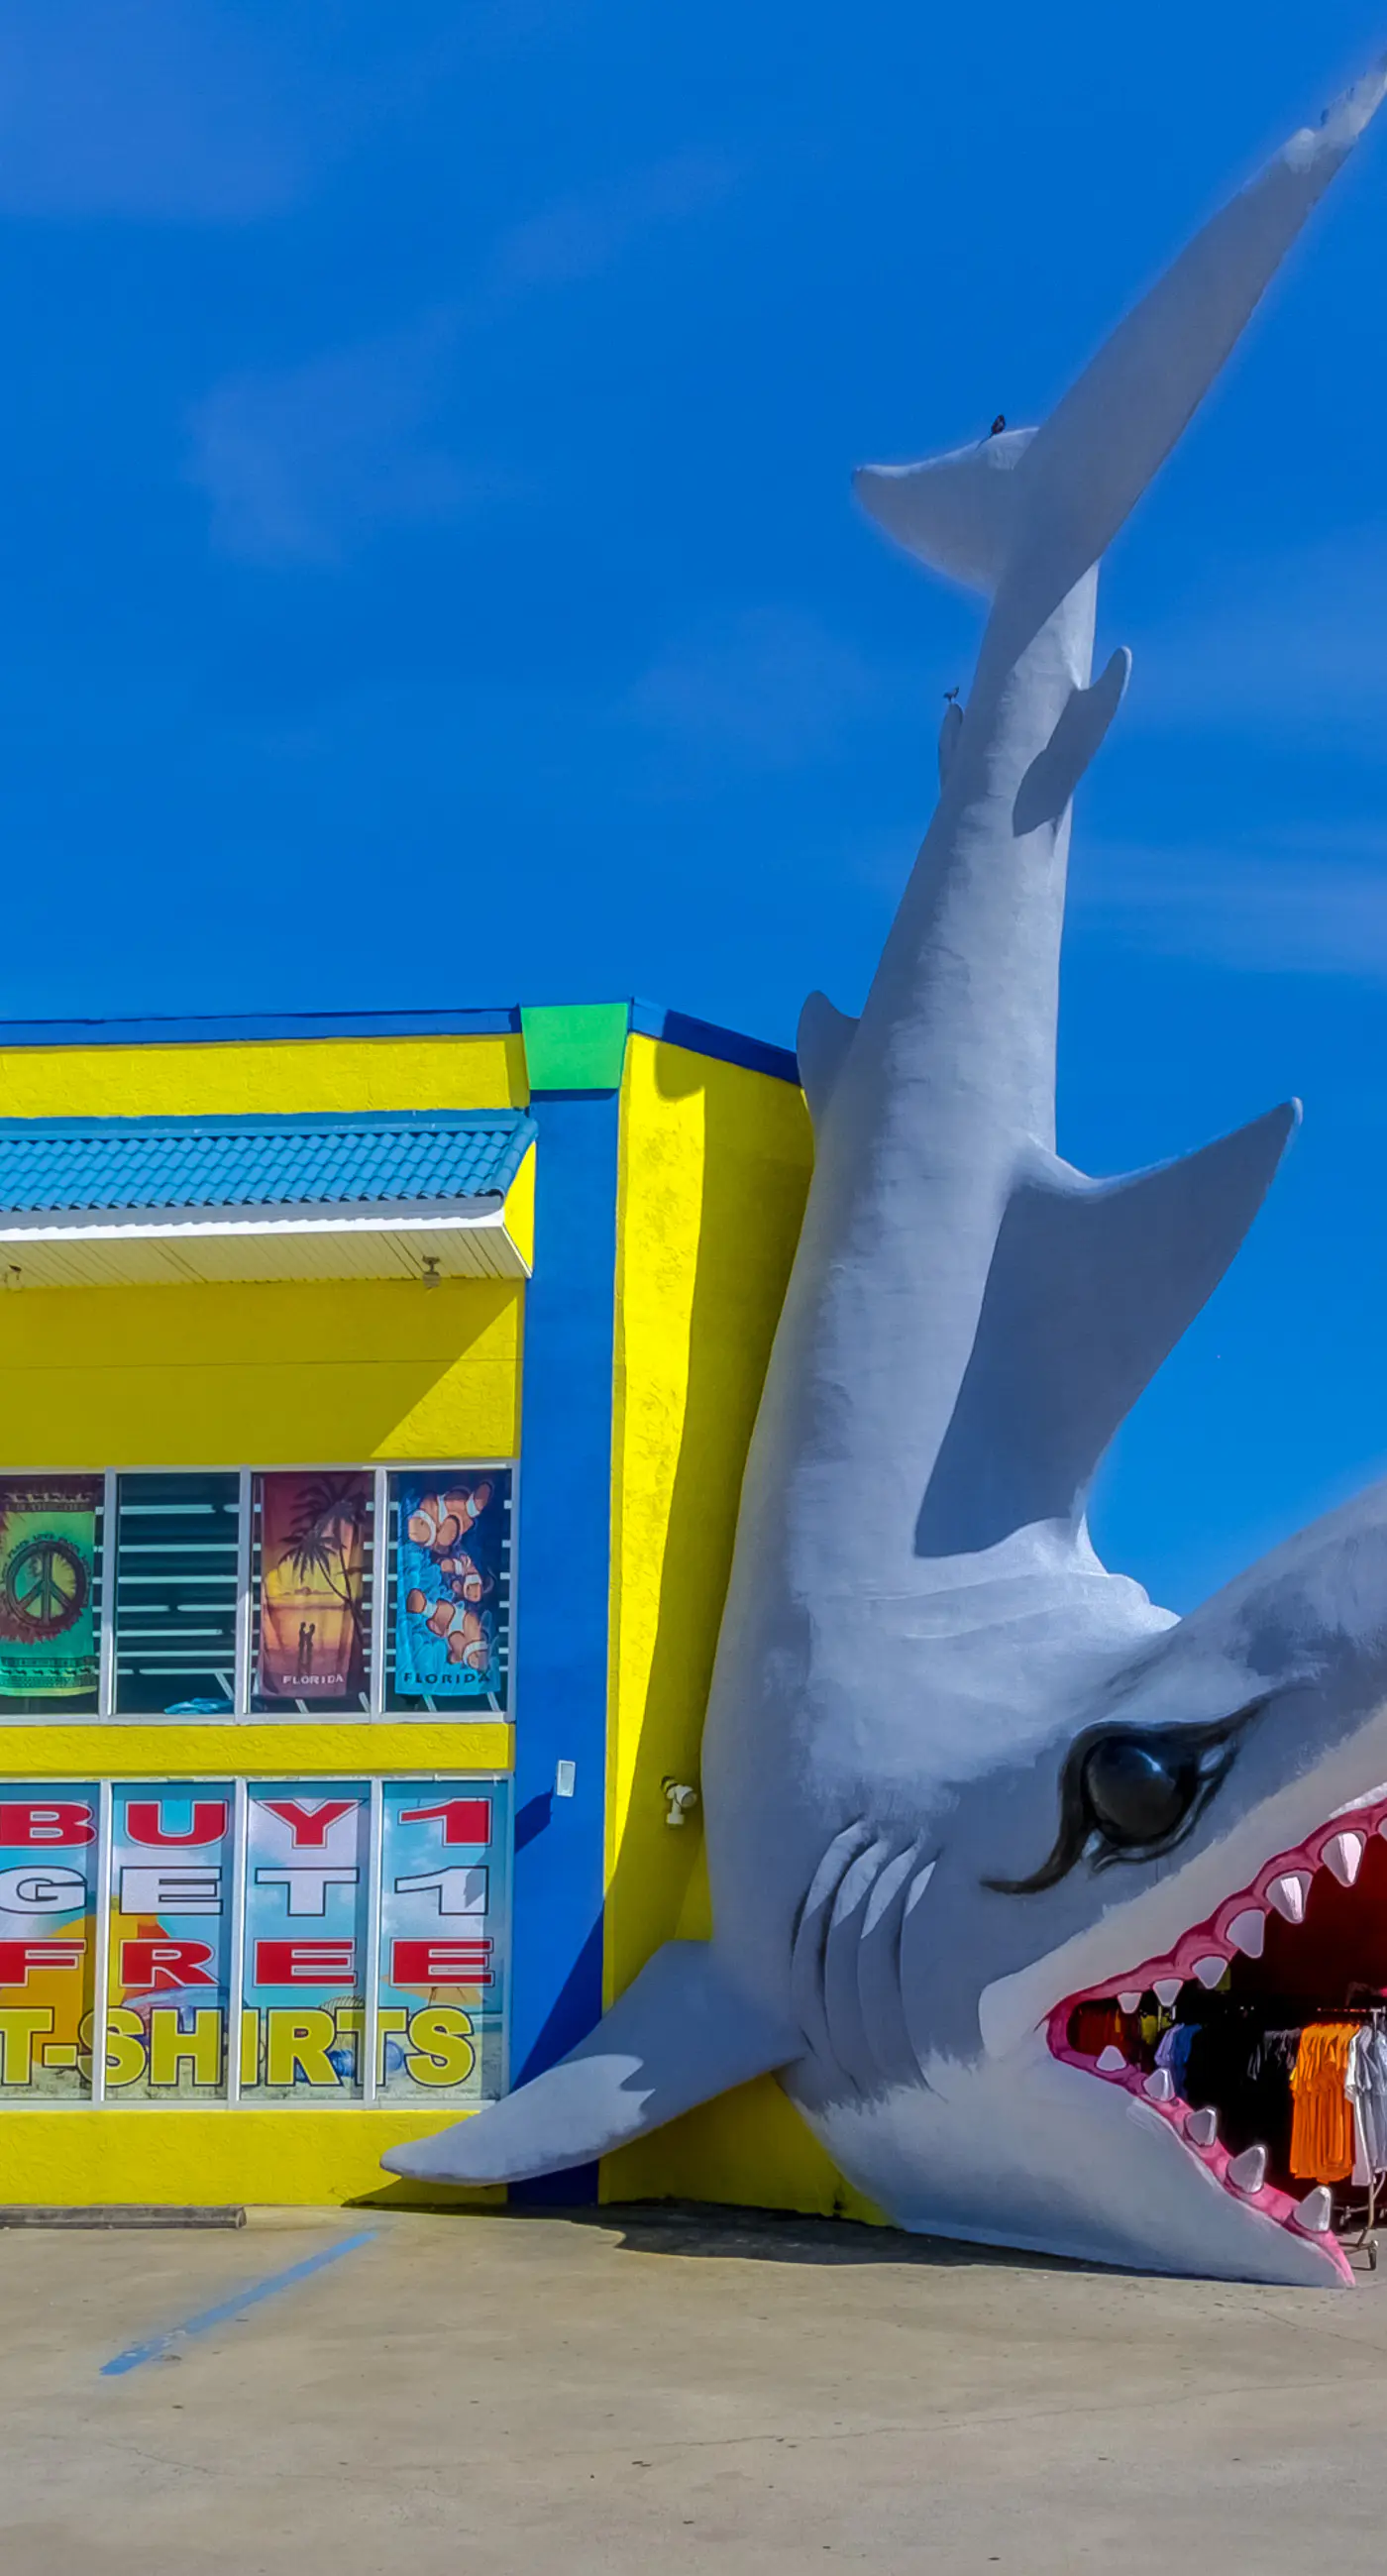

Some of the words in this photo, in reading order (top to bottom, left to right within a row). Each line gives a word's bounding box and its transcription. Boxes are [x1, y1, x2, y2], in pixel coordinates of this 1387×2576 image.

[283, 1672, 345, 1685] FLORIDA
[403, 1670, 491, 1684] FLORIDA
[0, 1798, 370, 1850] BUY
[398, 1797, 493, 1850] 1
[0, 1865, 361, 1916] GET
[395, 1865, 489, 1916] 1
[0, 1937, 495, 1988] FREE
[0, 2004, 476, 2089] T-SHIRTS
